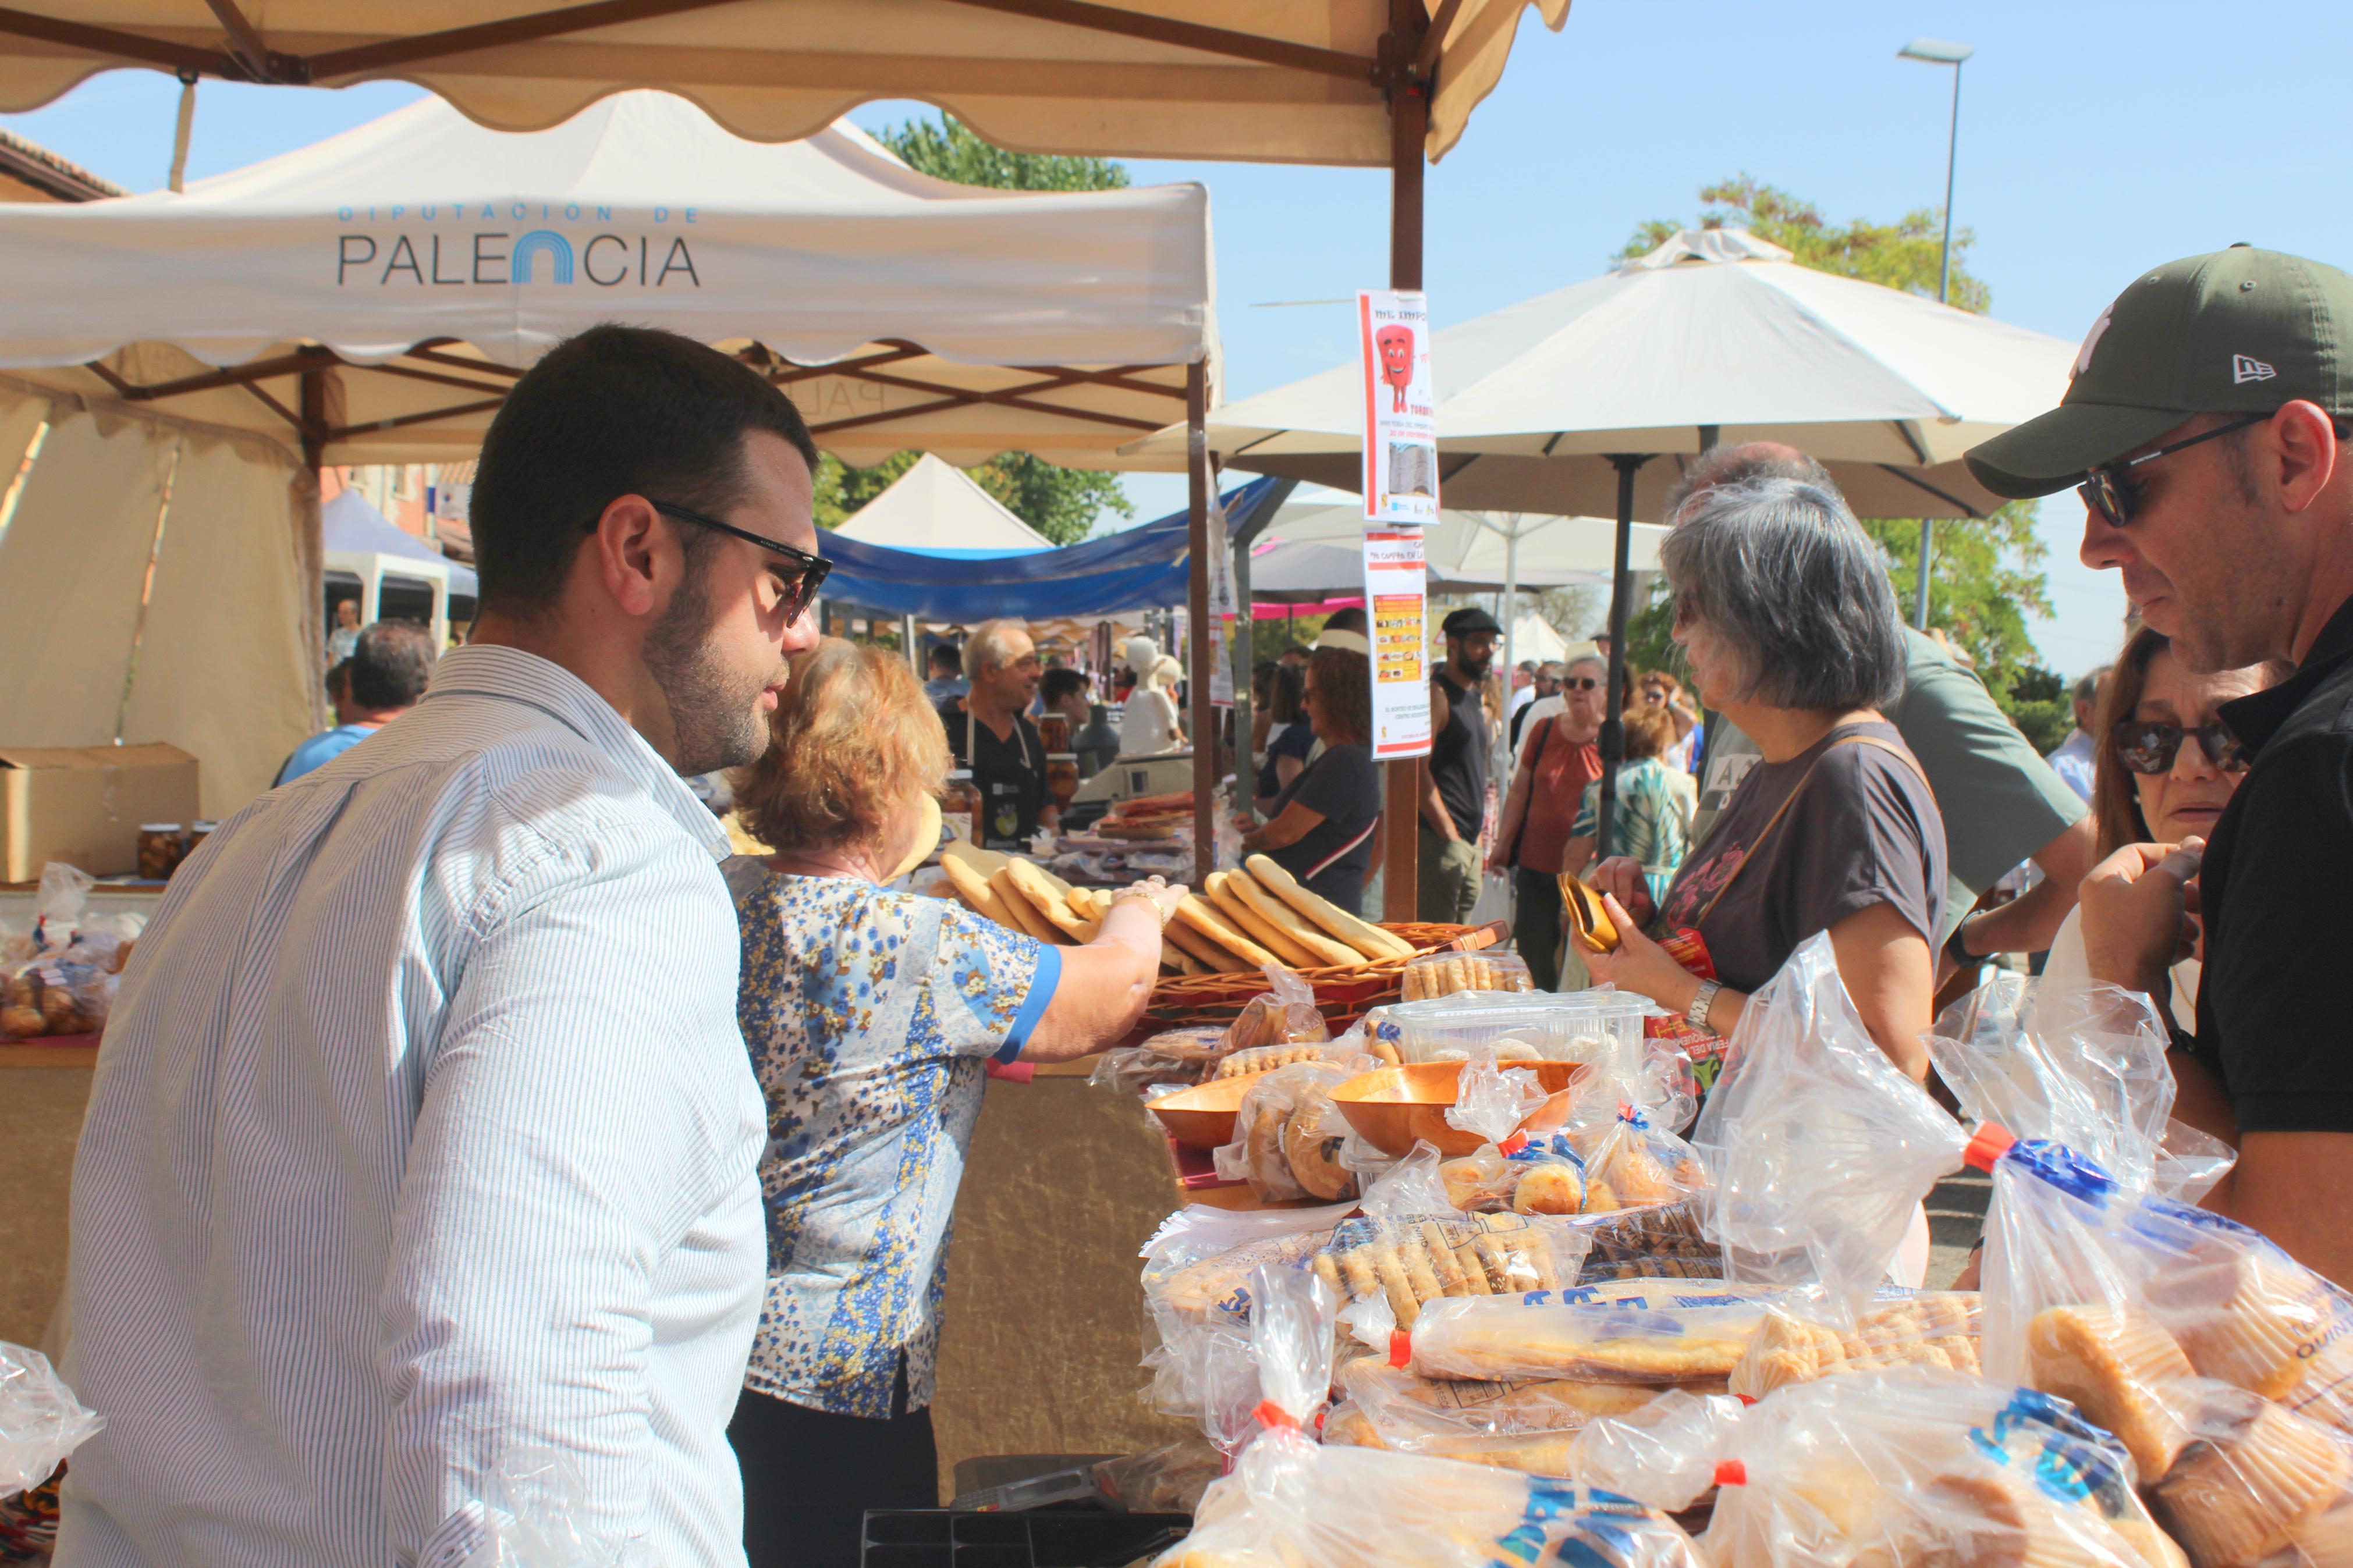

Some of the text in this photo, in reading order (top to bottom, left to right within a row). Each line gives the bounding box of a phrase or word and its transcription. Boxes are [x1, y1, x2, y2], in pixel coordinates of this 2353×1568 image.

[339, 202, 698, 223] DIPUTACIÓN DE
[337, 229, 700, 287] PALENCIA
[1690, 1044, 1706, 1055] DEL
